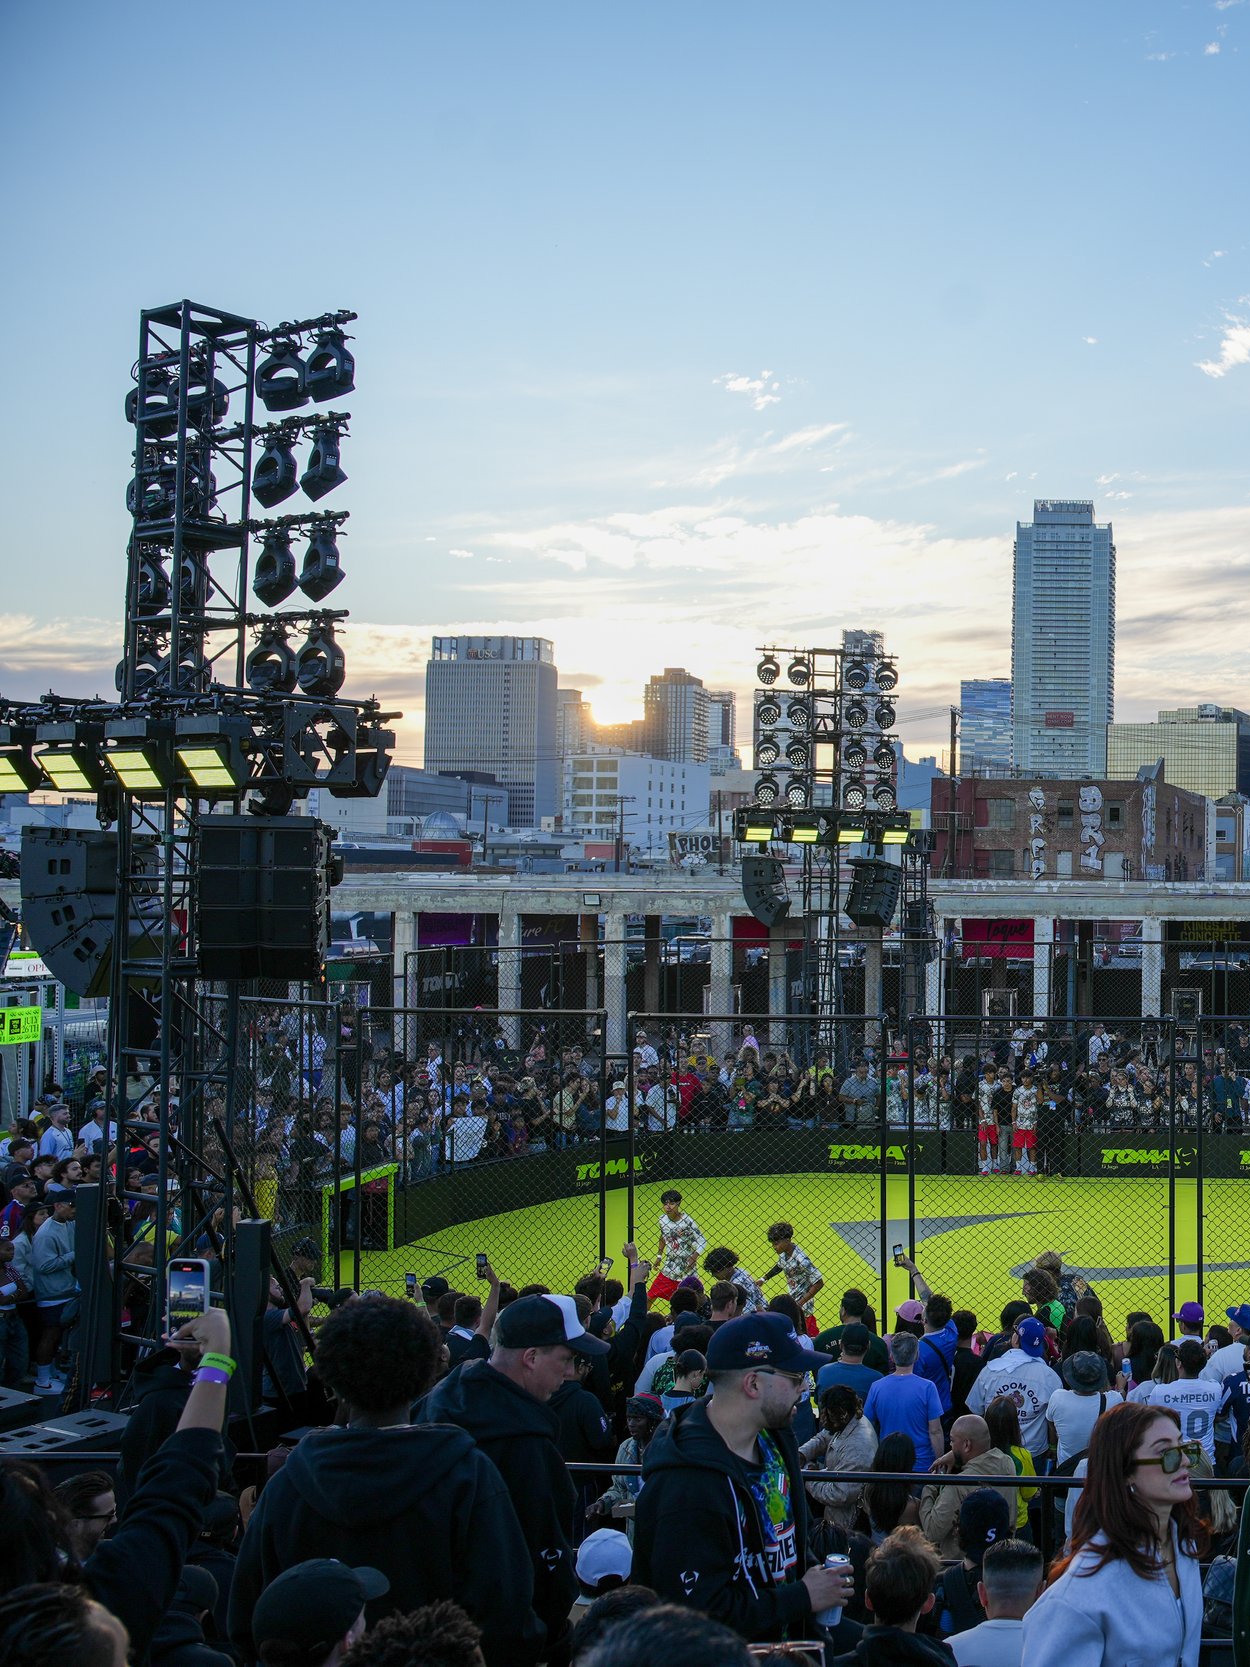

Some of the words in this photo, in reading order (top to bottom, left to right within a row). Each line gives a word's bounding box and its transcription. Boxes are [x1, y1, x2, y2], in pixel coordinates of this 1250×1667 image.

[478, 649, 498, 659] USC
[1180, 931, 1242, 941] CONCRETE
[1101, 1148, 1181, 1165] TOMA
[985, 1527, 997, 1542] S
